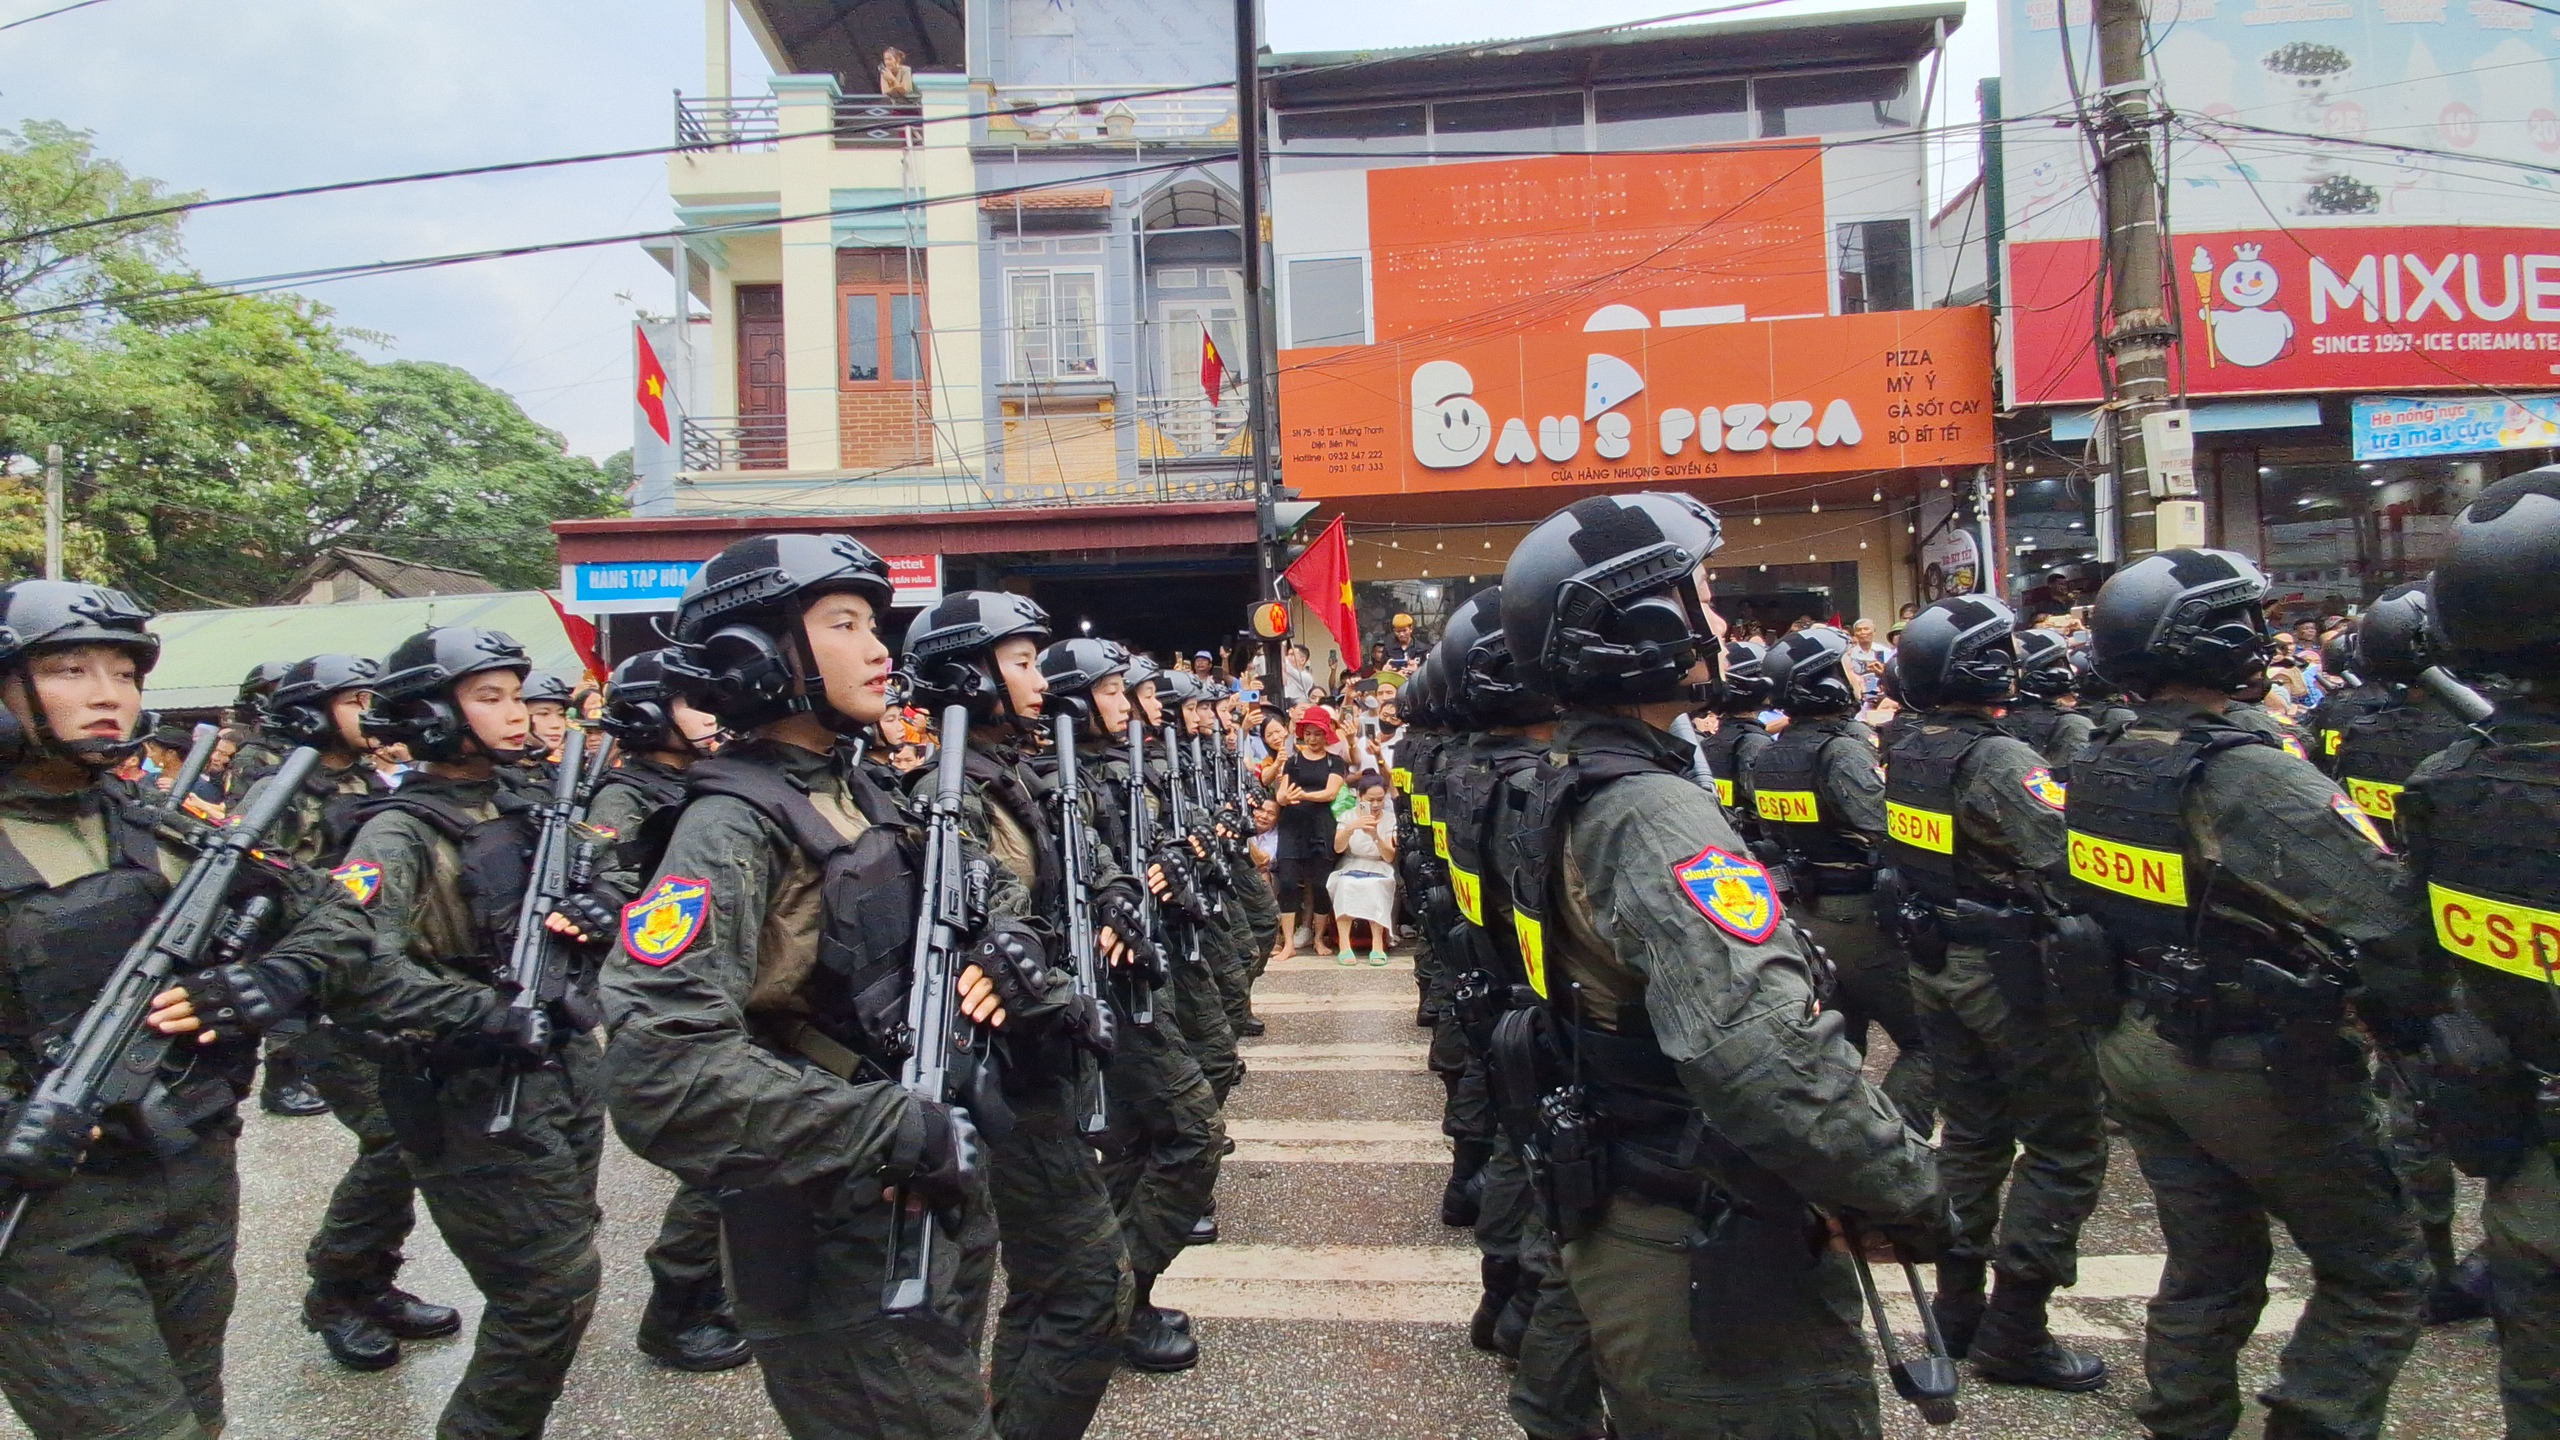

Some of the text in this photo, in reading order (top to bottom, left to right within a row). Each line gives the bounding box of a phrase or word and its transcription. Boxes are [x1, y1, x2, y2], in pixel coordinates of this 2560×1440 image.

[2309, 252, 2560, 325] MIXUE
[2312, 335, 2371, 354] SINCE
[2424, 334, 2453, 351] ICE
[2535, 332, 2560, 350] TE
[1886, 349, 1933, 367] PIZZA
[1887, 370, 1936, 393] MỲ Ý
[1888, 397, 1980, 418] GÀ SỐT CAY
[2371, 410, 2392, 426] Hè
[2396, 406, 2434, 424] nóng
[1660, 398, 1864, 456] PIZZA
[1888, 425, 1910, 444] BÒ
[1939, 422, 1962, 441] TẾT
[1328, 451, 1348, 460] 0932
[1368, 450, 1383, 459] 222
[1329, 465, 1347, 474] 0931
[1368, 463, 1384, 471] 333
[1551, 466, 1574, 482] CỬA
[1578, 467, 1610, 481] HÀNG
[1614, 465, 1661, 480] NHƯỢNG
[1705, 462, 1718, 474] 63
[589, 564, 688, 592] HÀNG TẠP HÓA
[1758, 796, 1808, 817] CSĐN
[1888, 808, 1941, 845] CSĐN
[2072, 840, 2166, 893] CSĐN
